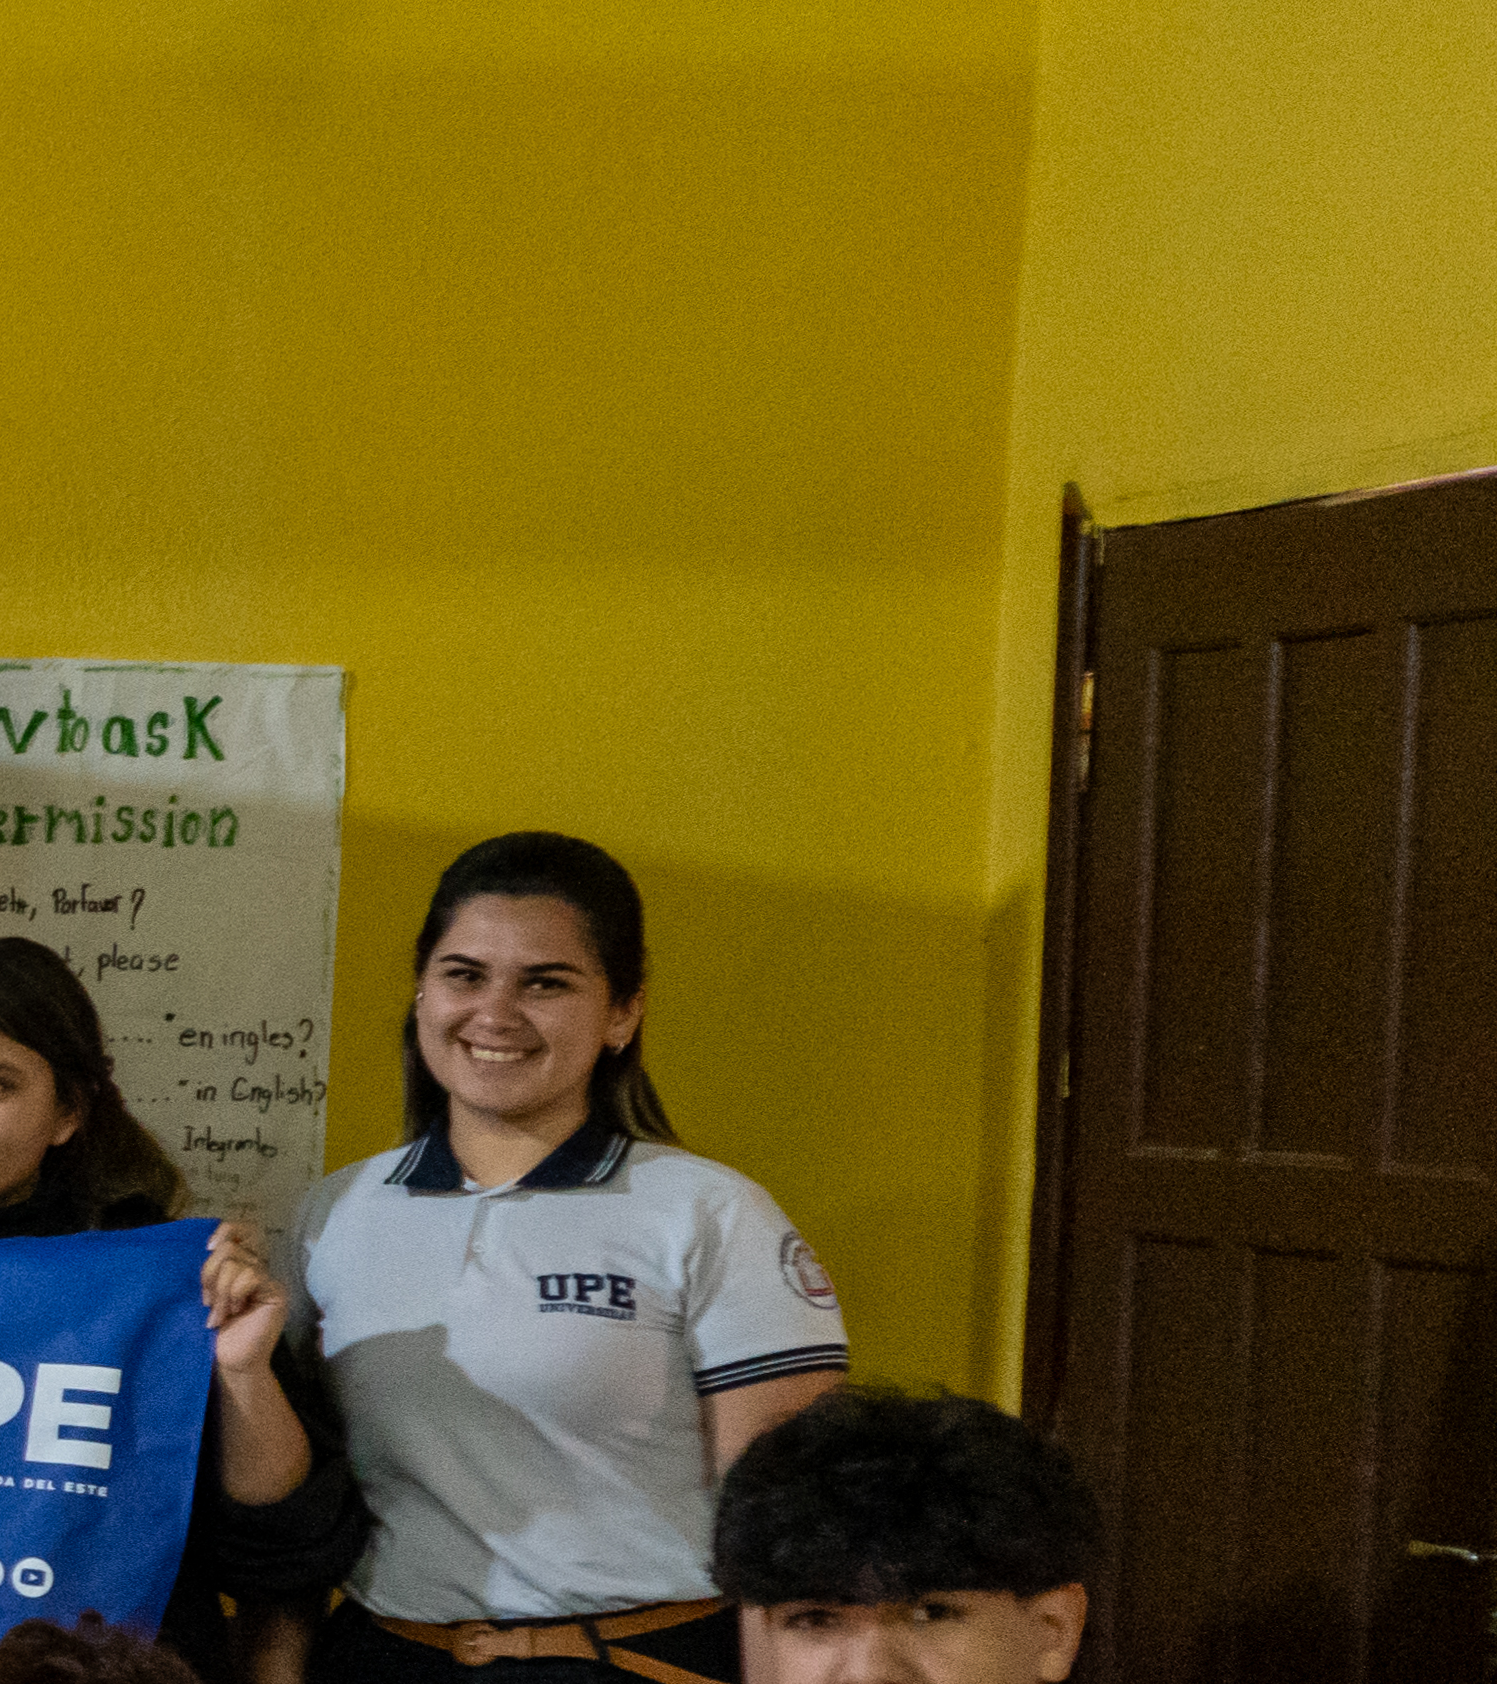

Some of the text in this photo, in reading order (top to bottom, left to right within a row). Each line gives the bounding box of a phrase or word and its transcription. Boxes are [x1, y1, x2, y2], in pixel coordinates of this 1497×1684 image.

[98, 942, 179, 982] please
[537, 1273, 636, 1311] UPE
[24, 1478, 55, 1490] DEL
[64, 1481, 108, 1497] ESTE
